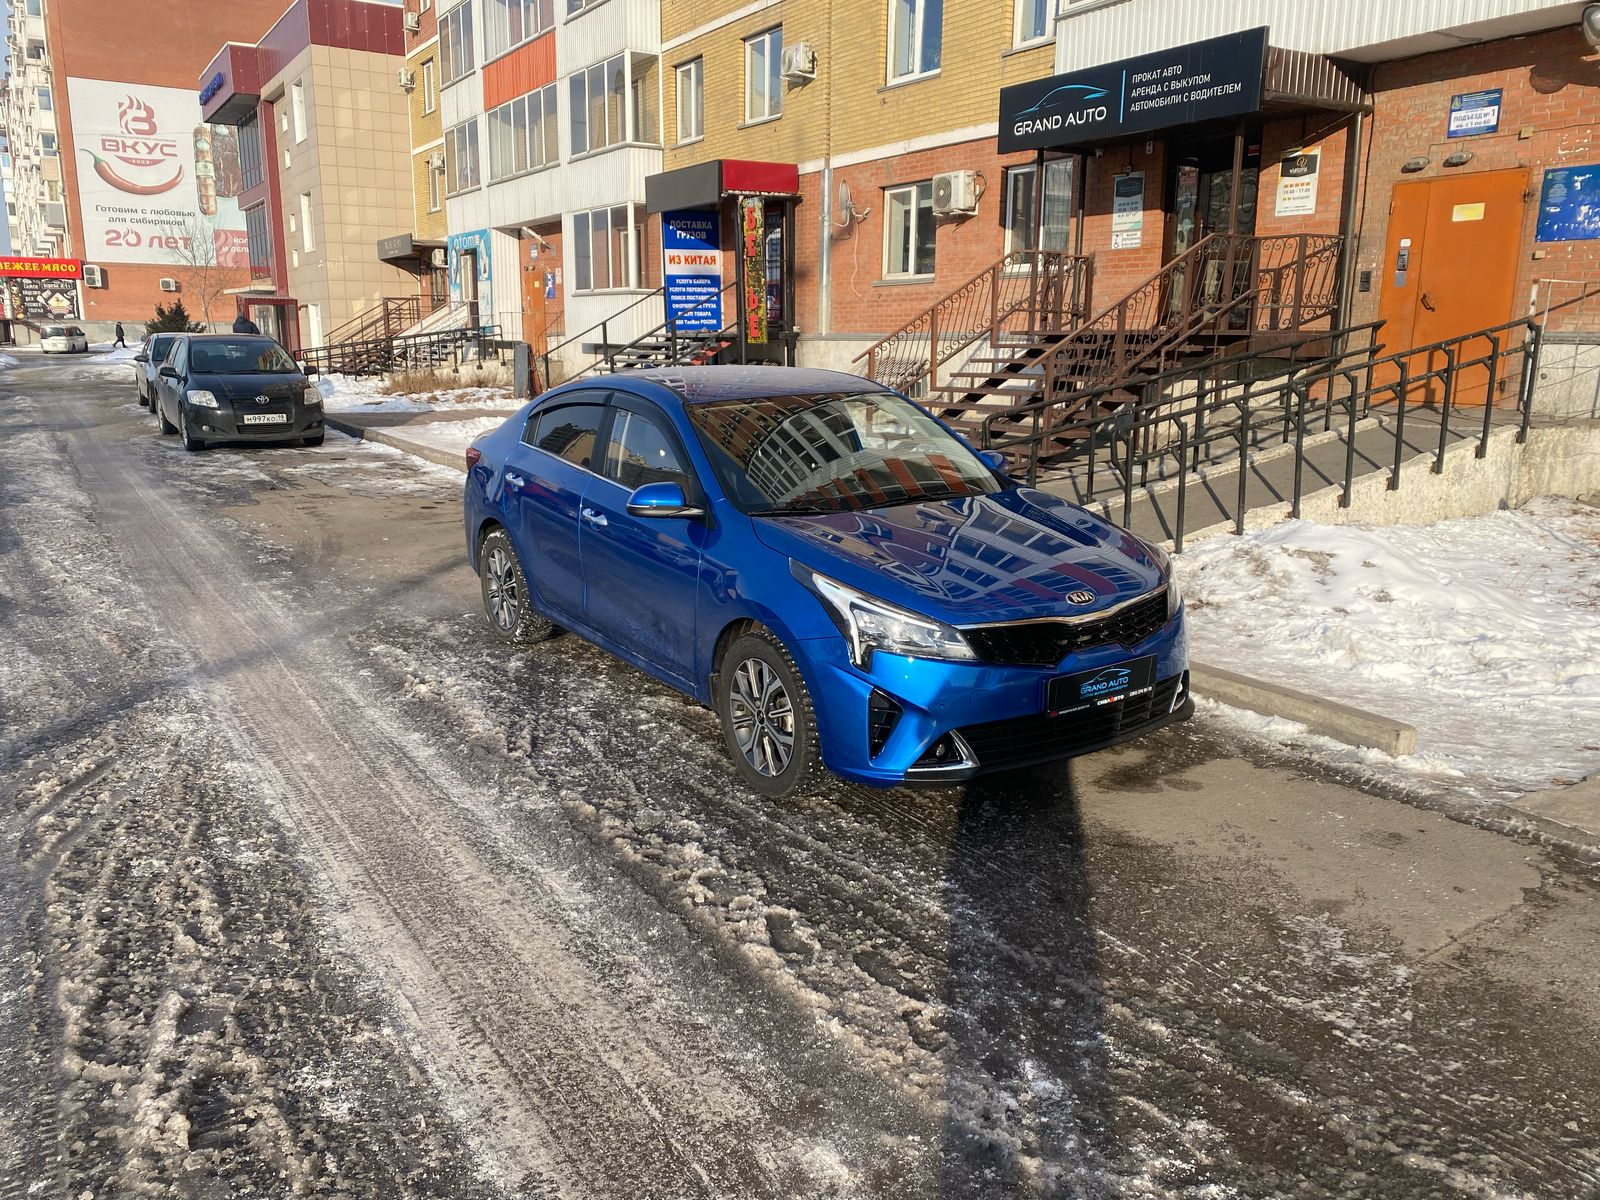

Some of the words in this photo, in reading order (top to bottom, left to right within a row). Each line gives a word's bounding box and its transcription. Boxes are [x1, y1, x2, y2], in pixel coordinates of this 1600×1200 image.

[1132, 69, 1161, 84] ПРОКАТ
[1162, 64, 1182, 78] АВТО
[1131, 83, 1162, 98] АРЕНДА
[1164, 82, 1169, 91] С
[1170, 73, 1211, 90] ВЫКУПОМ
[1130, 94, 1182, 112] АВТОМОБИЛИ
[1184, 93, 1188, 102] С
[1190, 82, 1242, 101] ВОДИТЕЛЕМ
[1014, 115, 1062, 136] GRAND
[1065, 106, 1107, 127] AUTO
[1454, 113, 1482, 123] ПОДЪЕЗД
[100, 138, 178, 158] ВКУС
[96, 204, 138, 214] Готовим
[150, 208, 196, 218] любовью
[130, 217, 186, 226] сибиряков!
[670, 220, 712, 230] ДОСТАВКА
[104, 227, 142, 248] 20
[149, 236, 192, 249] лет
[676, 230, 706, 239] ГРУЗОВ
[669, 254, 681, 264] ИЗ
[684, 254, 716, 264] КИТАЯ
[42, 264, 76, 272] МЯСО
[1070, 592, 1092, 602] KIA
[1080, 682, 1108, 694] GRAND
[1108, 676, 1128, 688] AUTO
